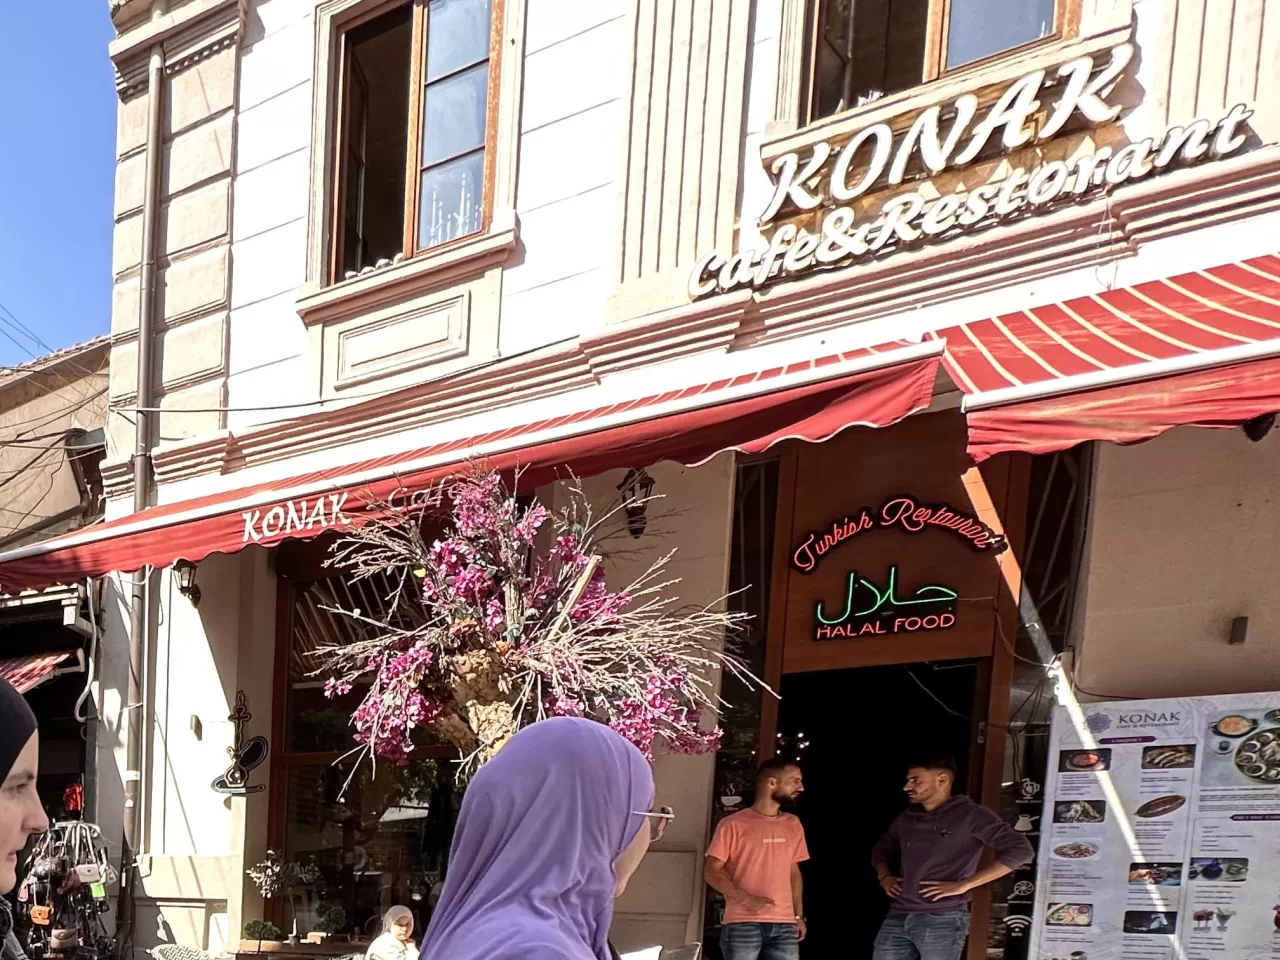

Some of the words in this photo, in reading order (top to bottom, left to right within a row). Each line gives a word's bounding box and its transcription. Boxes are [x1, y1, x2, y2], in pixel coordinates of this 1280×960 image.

[757, 42, 1135, 221] KONAK
[241, 491, 351, 542] KONAK
[793, 510, 873, 572] Turkish
[880, 498, 1002, 549] Restaurant
[817, 566, 959, 624] حلال
[816, 620, 887, 640] HALAL
[894, 613, 956, 633] FOOD
[1118, 711, 1181, 724] KONAK
